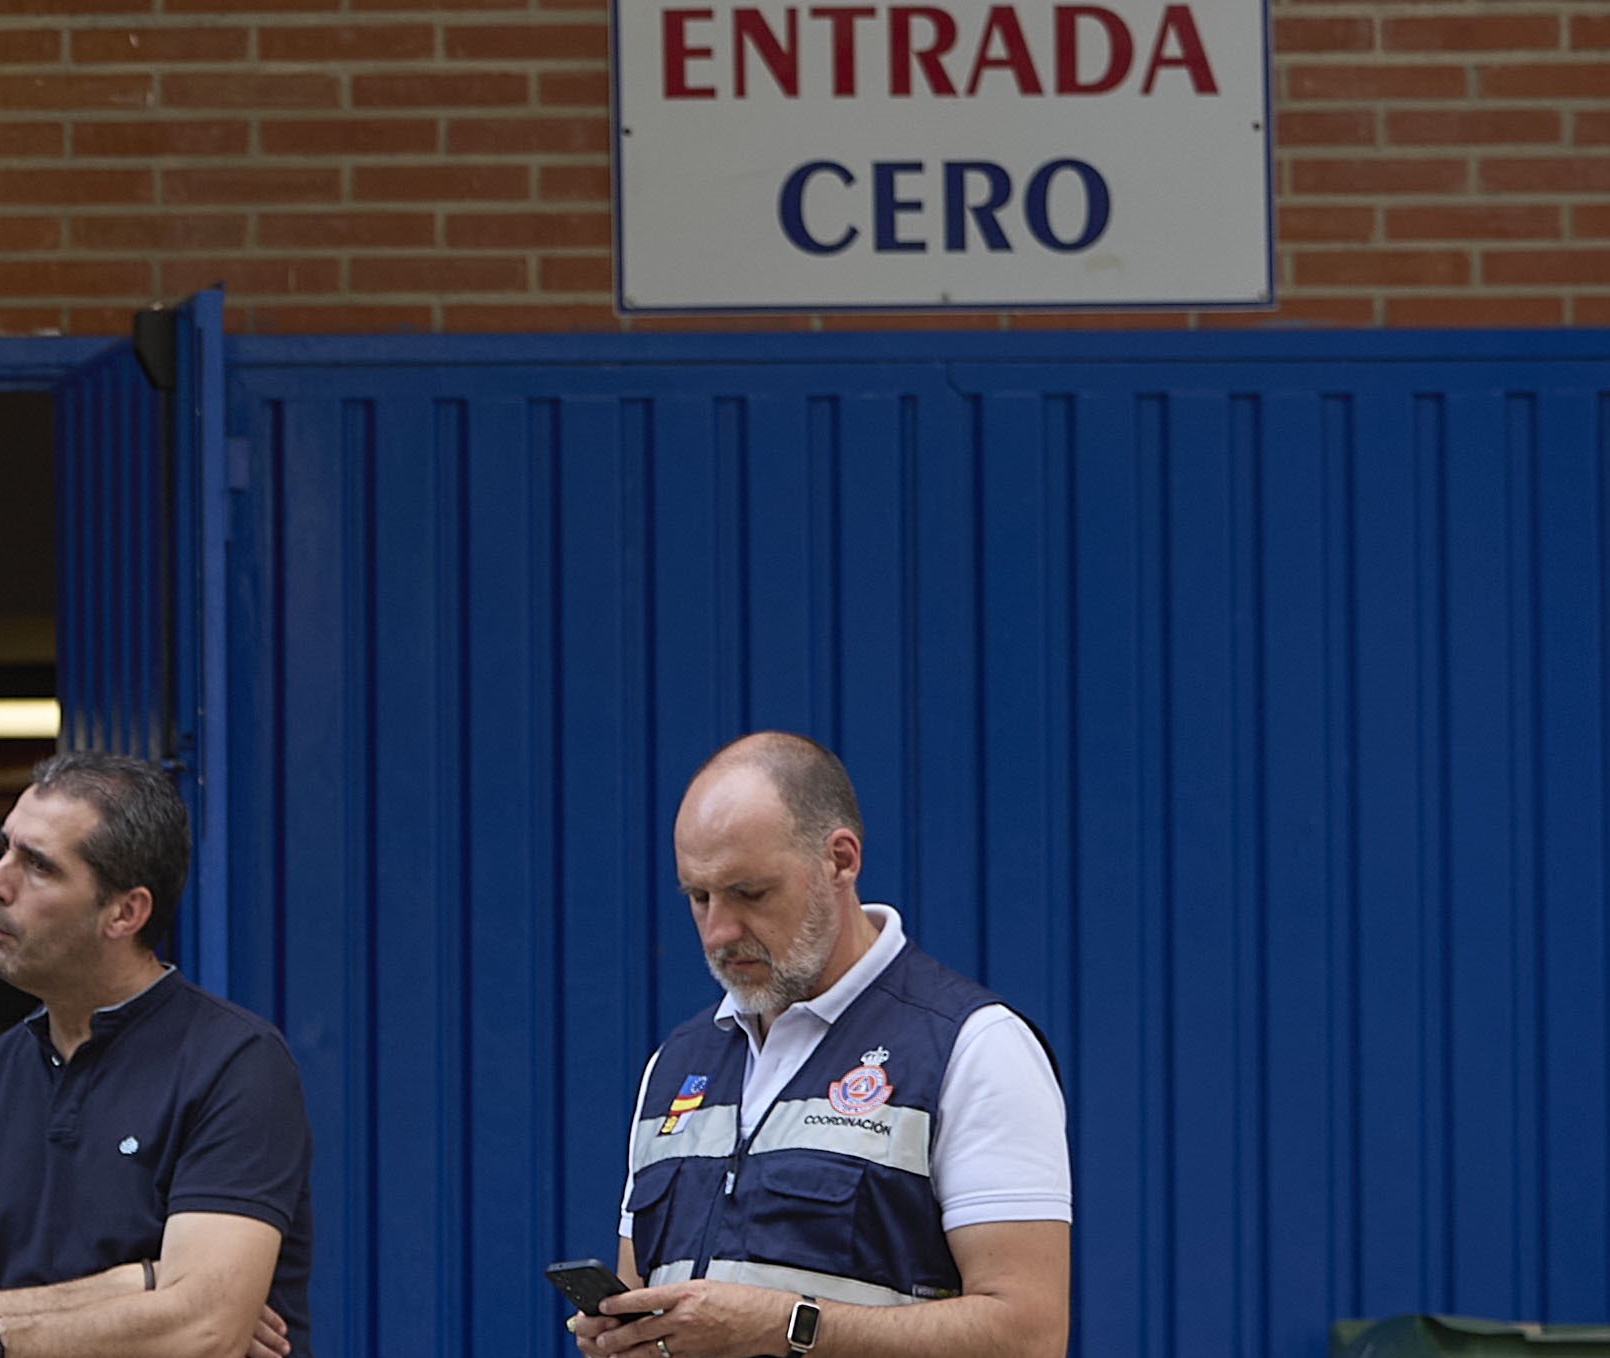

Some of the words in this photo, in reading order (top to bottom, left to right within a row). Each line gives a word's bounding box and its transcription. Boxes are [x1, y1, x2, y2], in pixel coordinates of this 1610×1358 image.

[661, 4, 1219, 100] ENTRADA
[779, 158, 1111, 255] CERO
[804, 1115, 892, 1137] COORDINACIÓN
